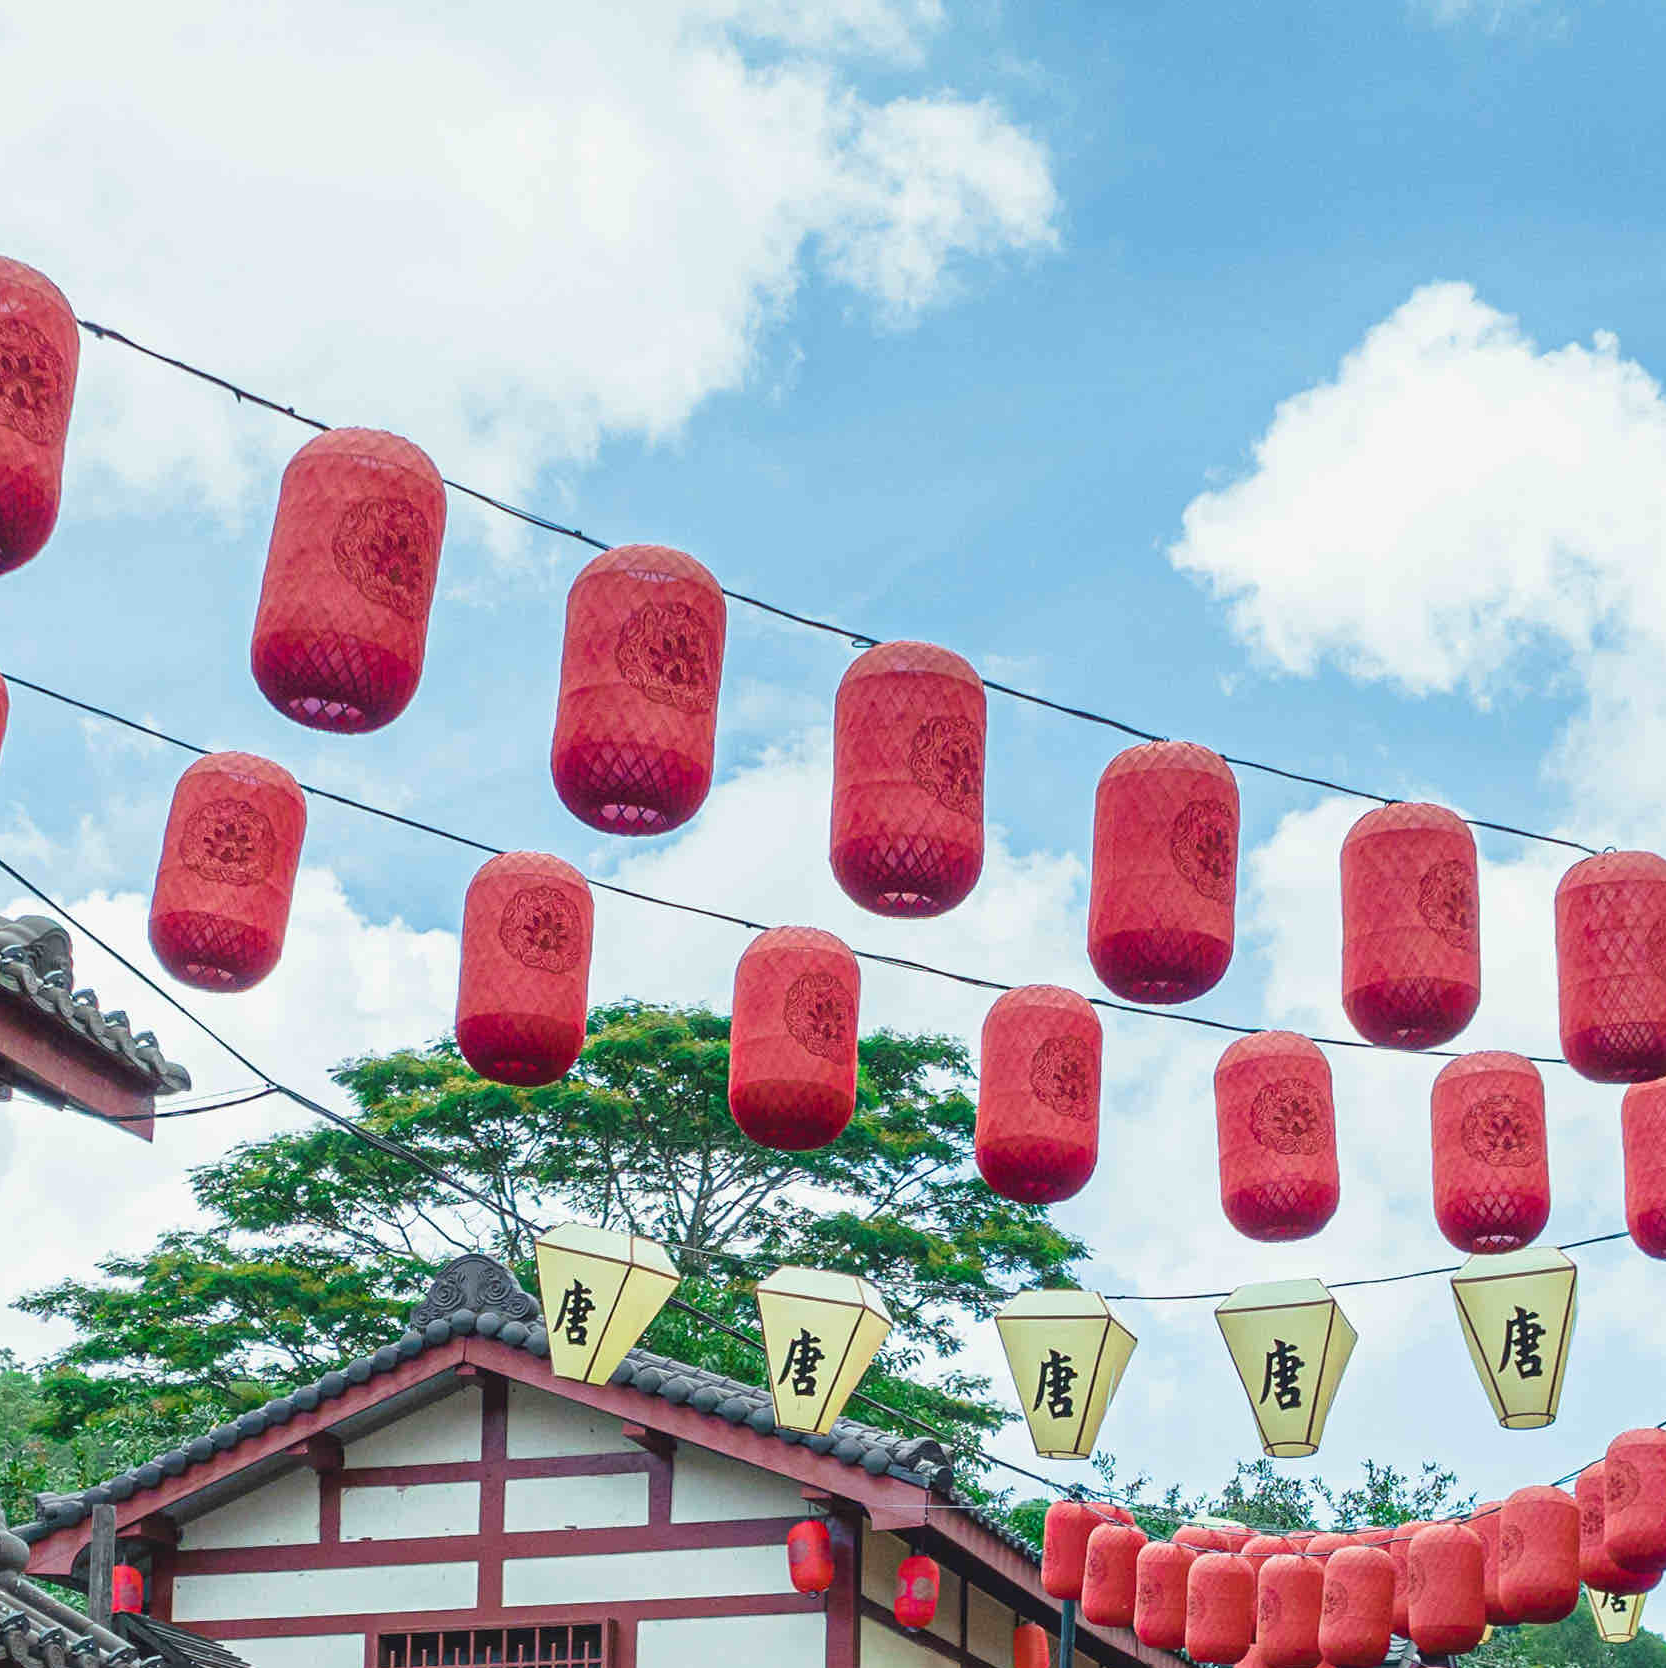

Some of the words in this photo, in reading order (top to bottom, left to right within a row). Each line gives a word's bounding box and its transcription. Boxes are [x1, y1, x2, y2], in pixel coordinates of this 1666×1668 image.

[553, 1279, 596, 1346] 唐
[1498, 1306, 1546, 1379] 唐
[778, 1327, 825, 1397] 唐
[1033, 1349, 1078, 1419] 唐
[1259, 1338, 1305, 1411] 唐
